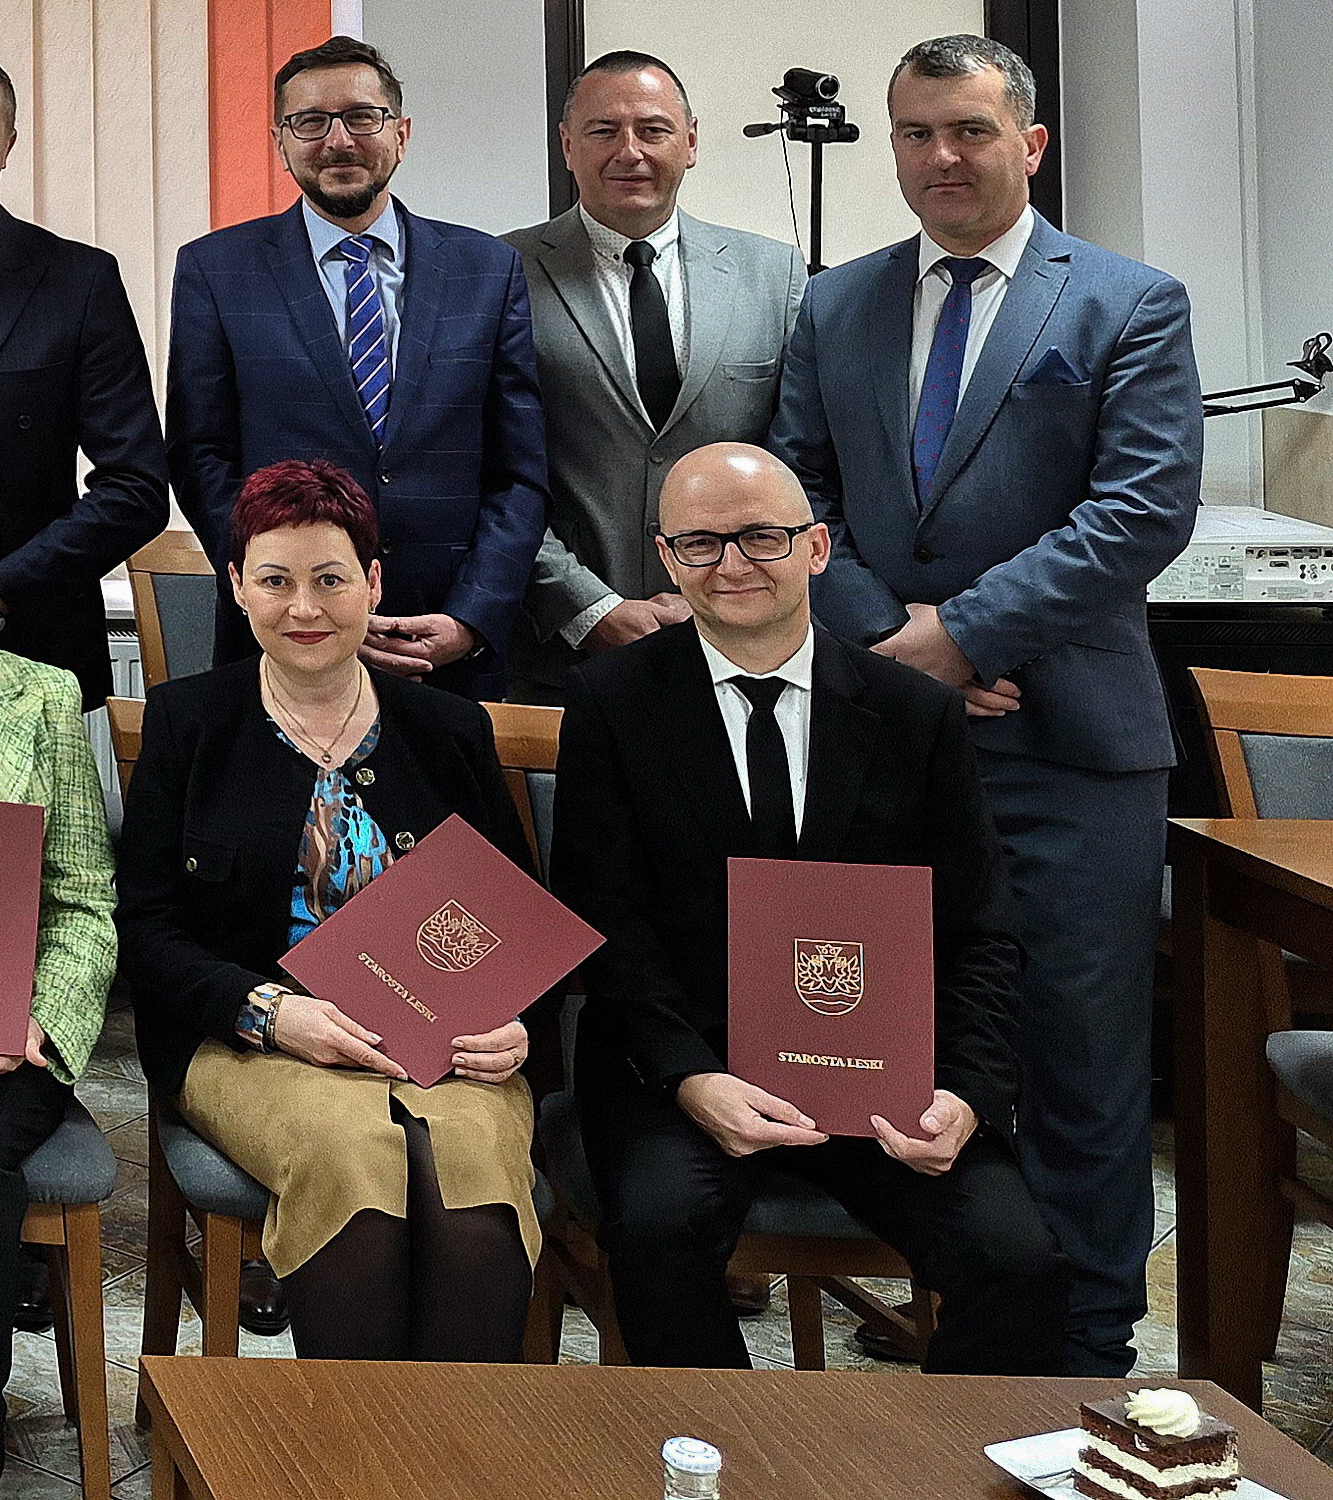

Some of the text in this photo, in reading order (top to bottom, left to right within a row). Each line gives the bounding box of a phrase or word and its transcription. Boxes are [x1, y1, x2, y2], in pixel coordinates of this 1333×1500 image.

[358, 952, 410, 1000] STAROSTA
[778, 1051, 885, 1070] STAROSTA LESKI
